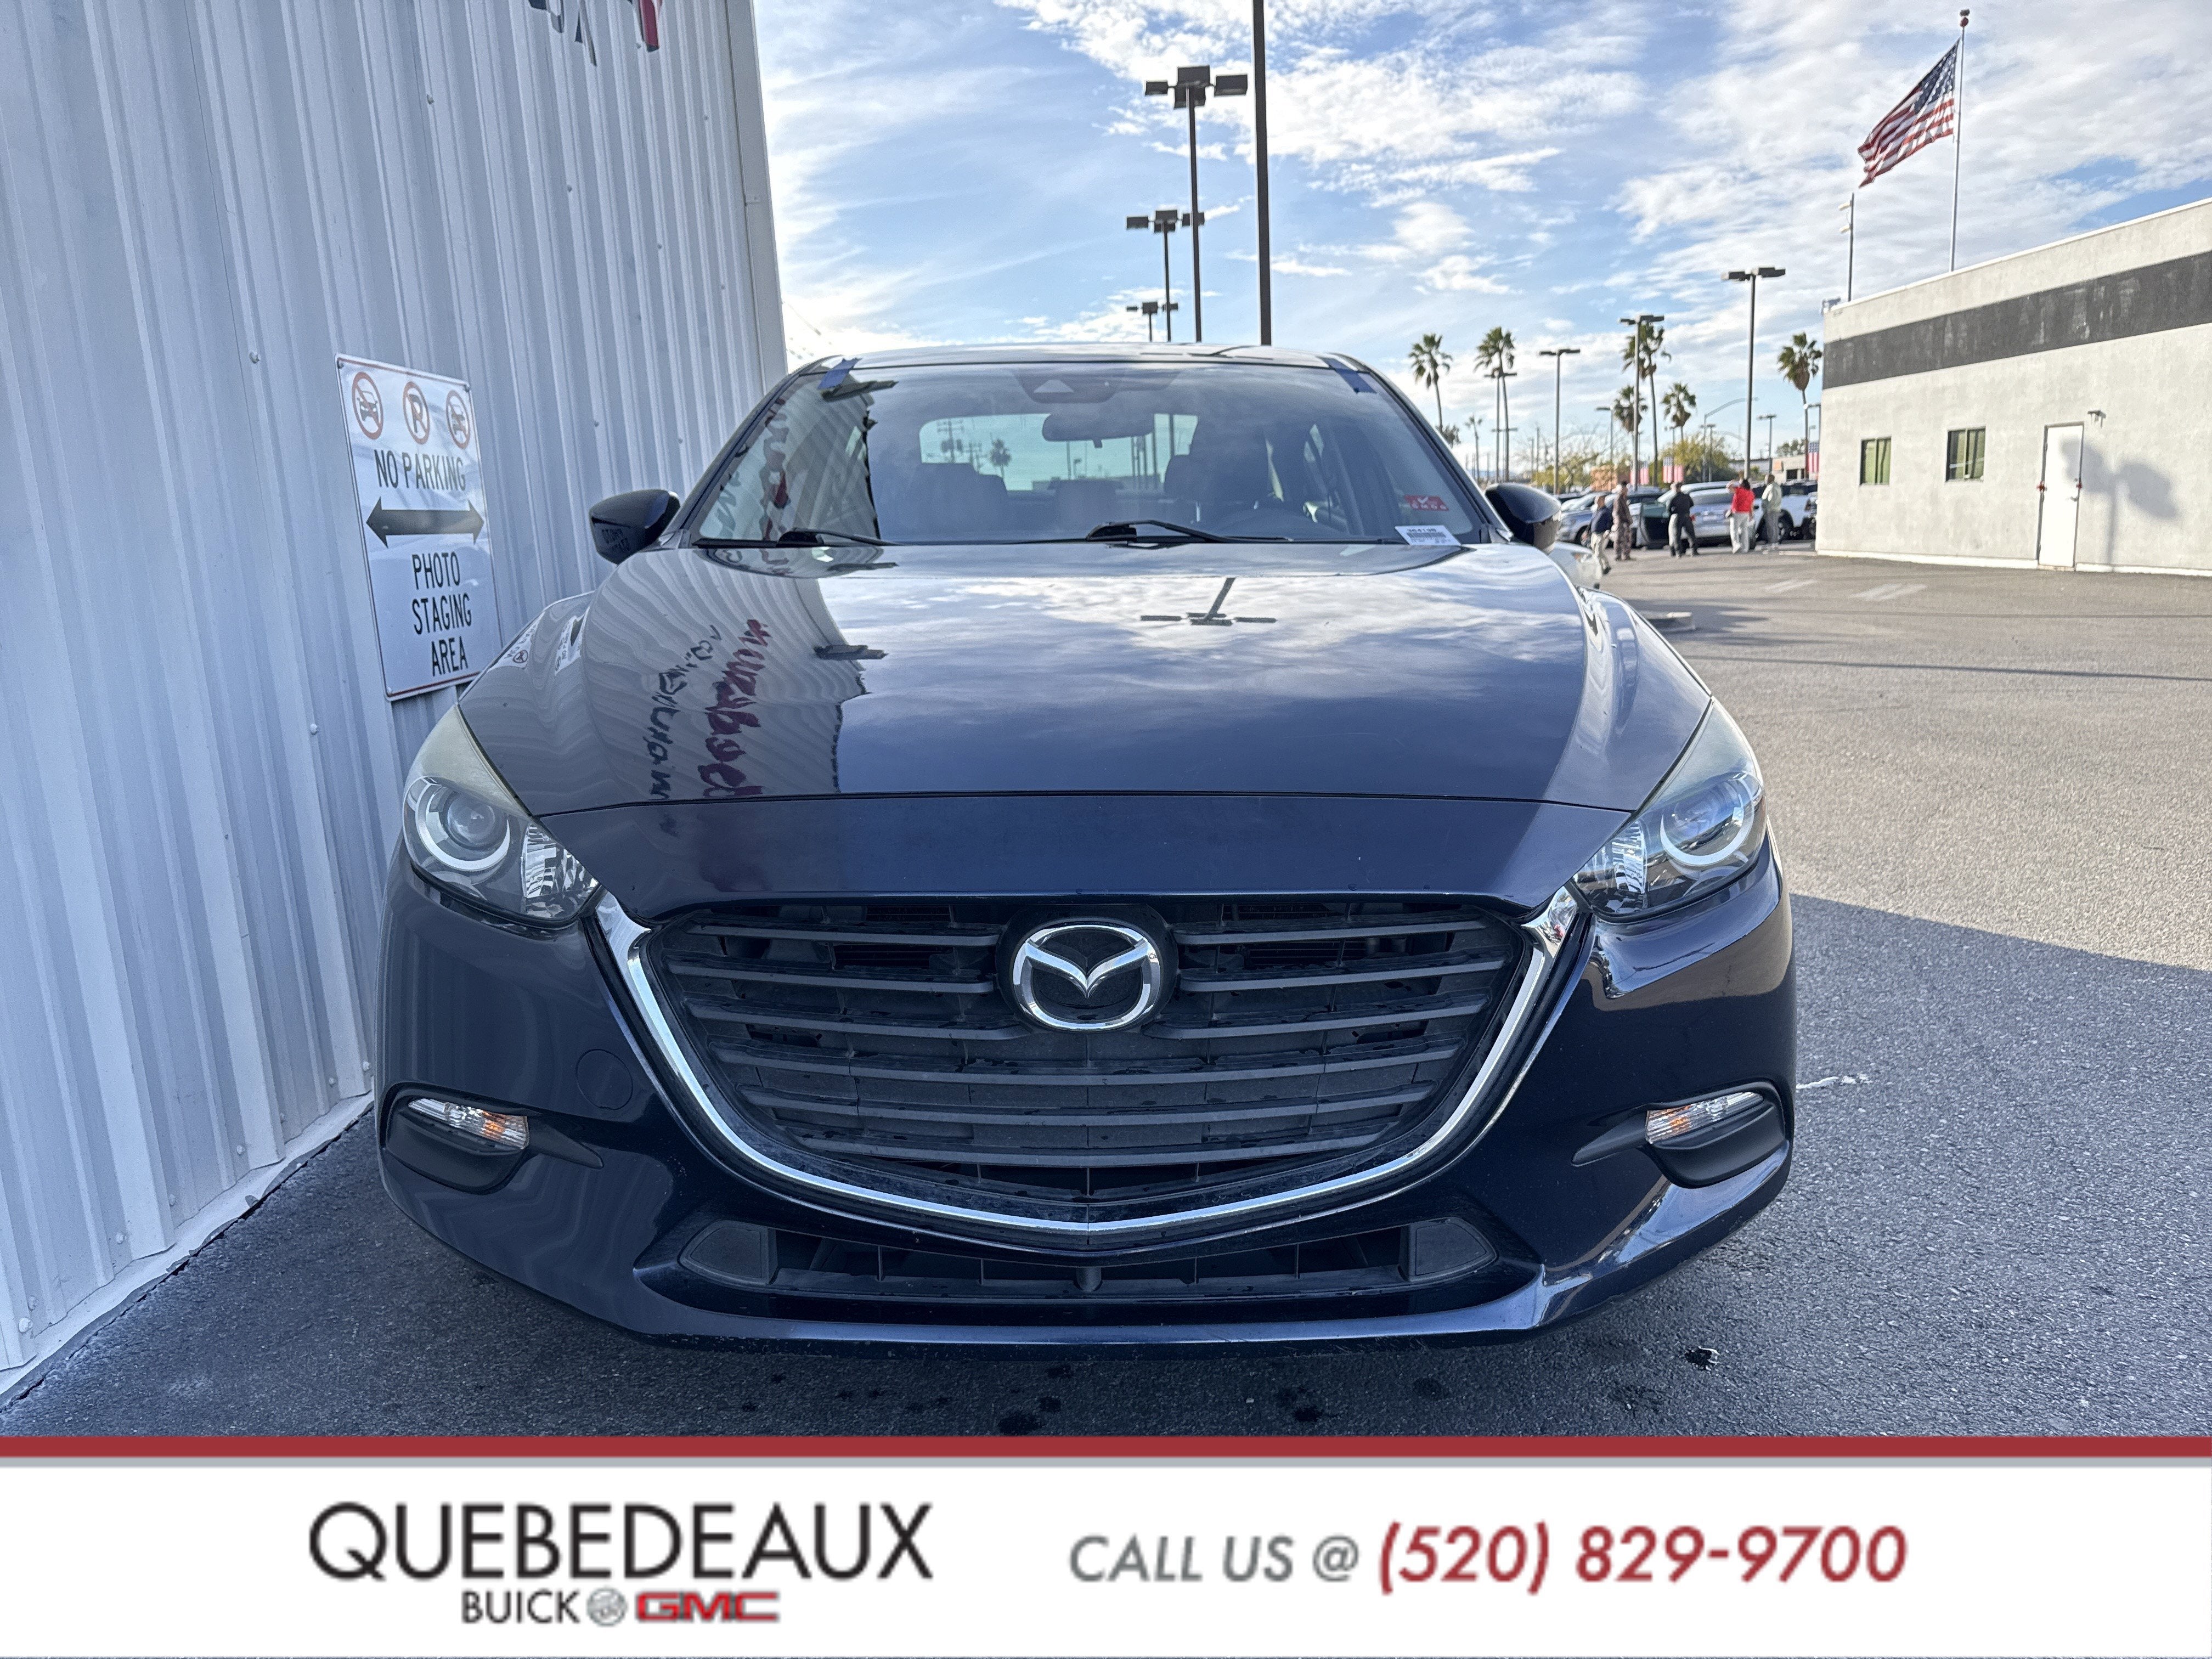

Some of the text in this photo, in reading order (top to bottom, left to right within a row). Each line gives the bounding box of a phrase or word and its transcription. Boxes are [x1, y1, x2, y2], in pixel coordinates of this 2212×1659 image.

[374, 449, 466, 492] NO PARKING
[412, 551, 461, 590] PHOTO
[412, 592, 472, 635] STAGING
[431, 635, 469, 677] AREA
